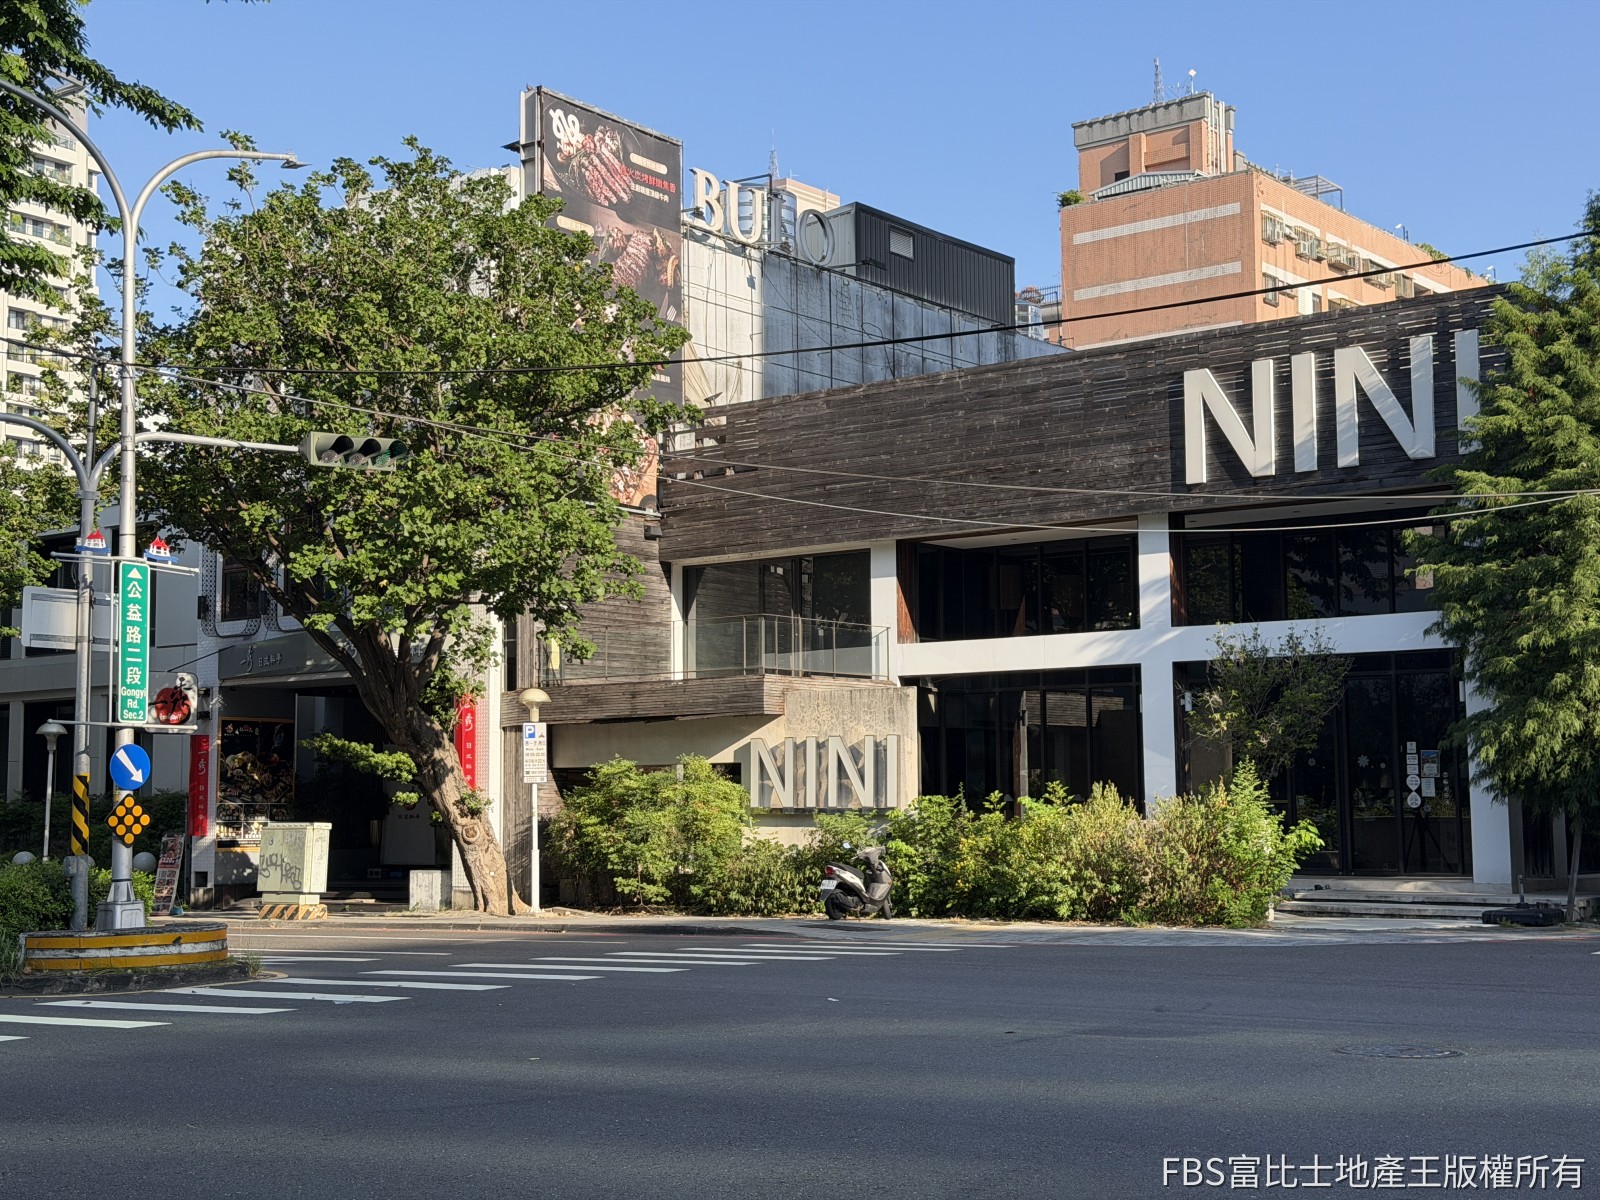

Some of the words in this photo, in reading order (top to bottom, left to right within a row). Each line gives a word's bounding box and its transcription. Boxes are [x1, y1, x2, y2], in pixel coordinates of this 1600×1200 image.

[1184, 329, 1483, 485] NINI
[125, 580, 143, 685] 公益路二段
[121, 687, 147, 699] Gongyi
[127, 699, 140, 709] Rd.
[123, 709, 144, 720] Sec.2
[526, 726, 534, 738] P
[750, 733, 898, 808] NINI
